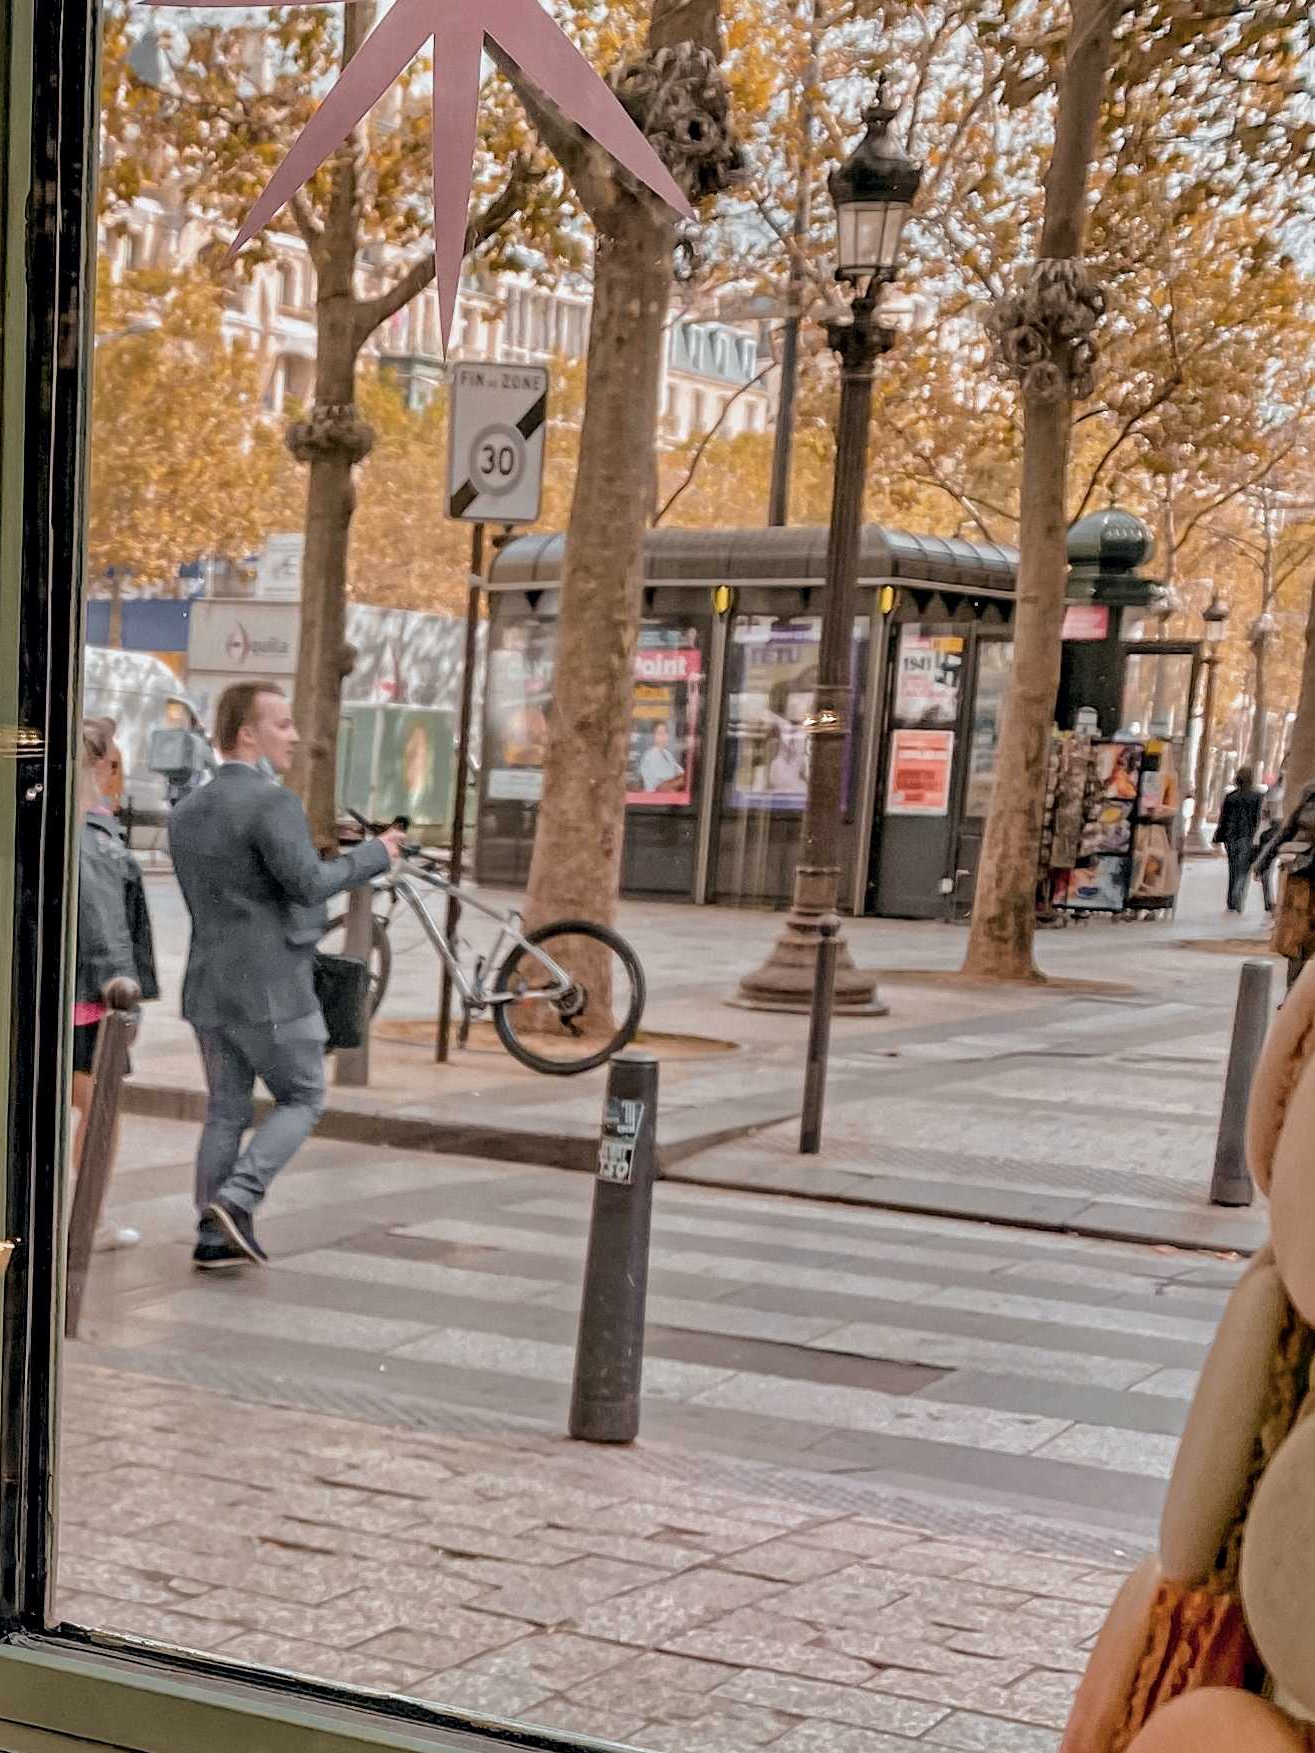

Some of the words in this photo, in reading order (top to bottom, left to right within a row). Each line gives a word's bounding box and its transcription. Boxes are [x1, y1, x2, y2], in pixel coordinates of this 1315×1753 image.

[461, 371, 484, 387] FIN
[501, 374, 541, 391] ZONE
[481, 443, 514, 476] 30
